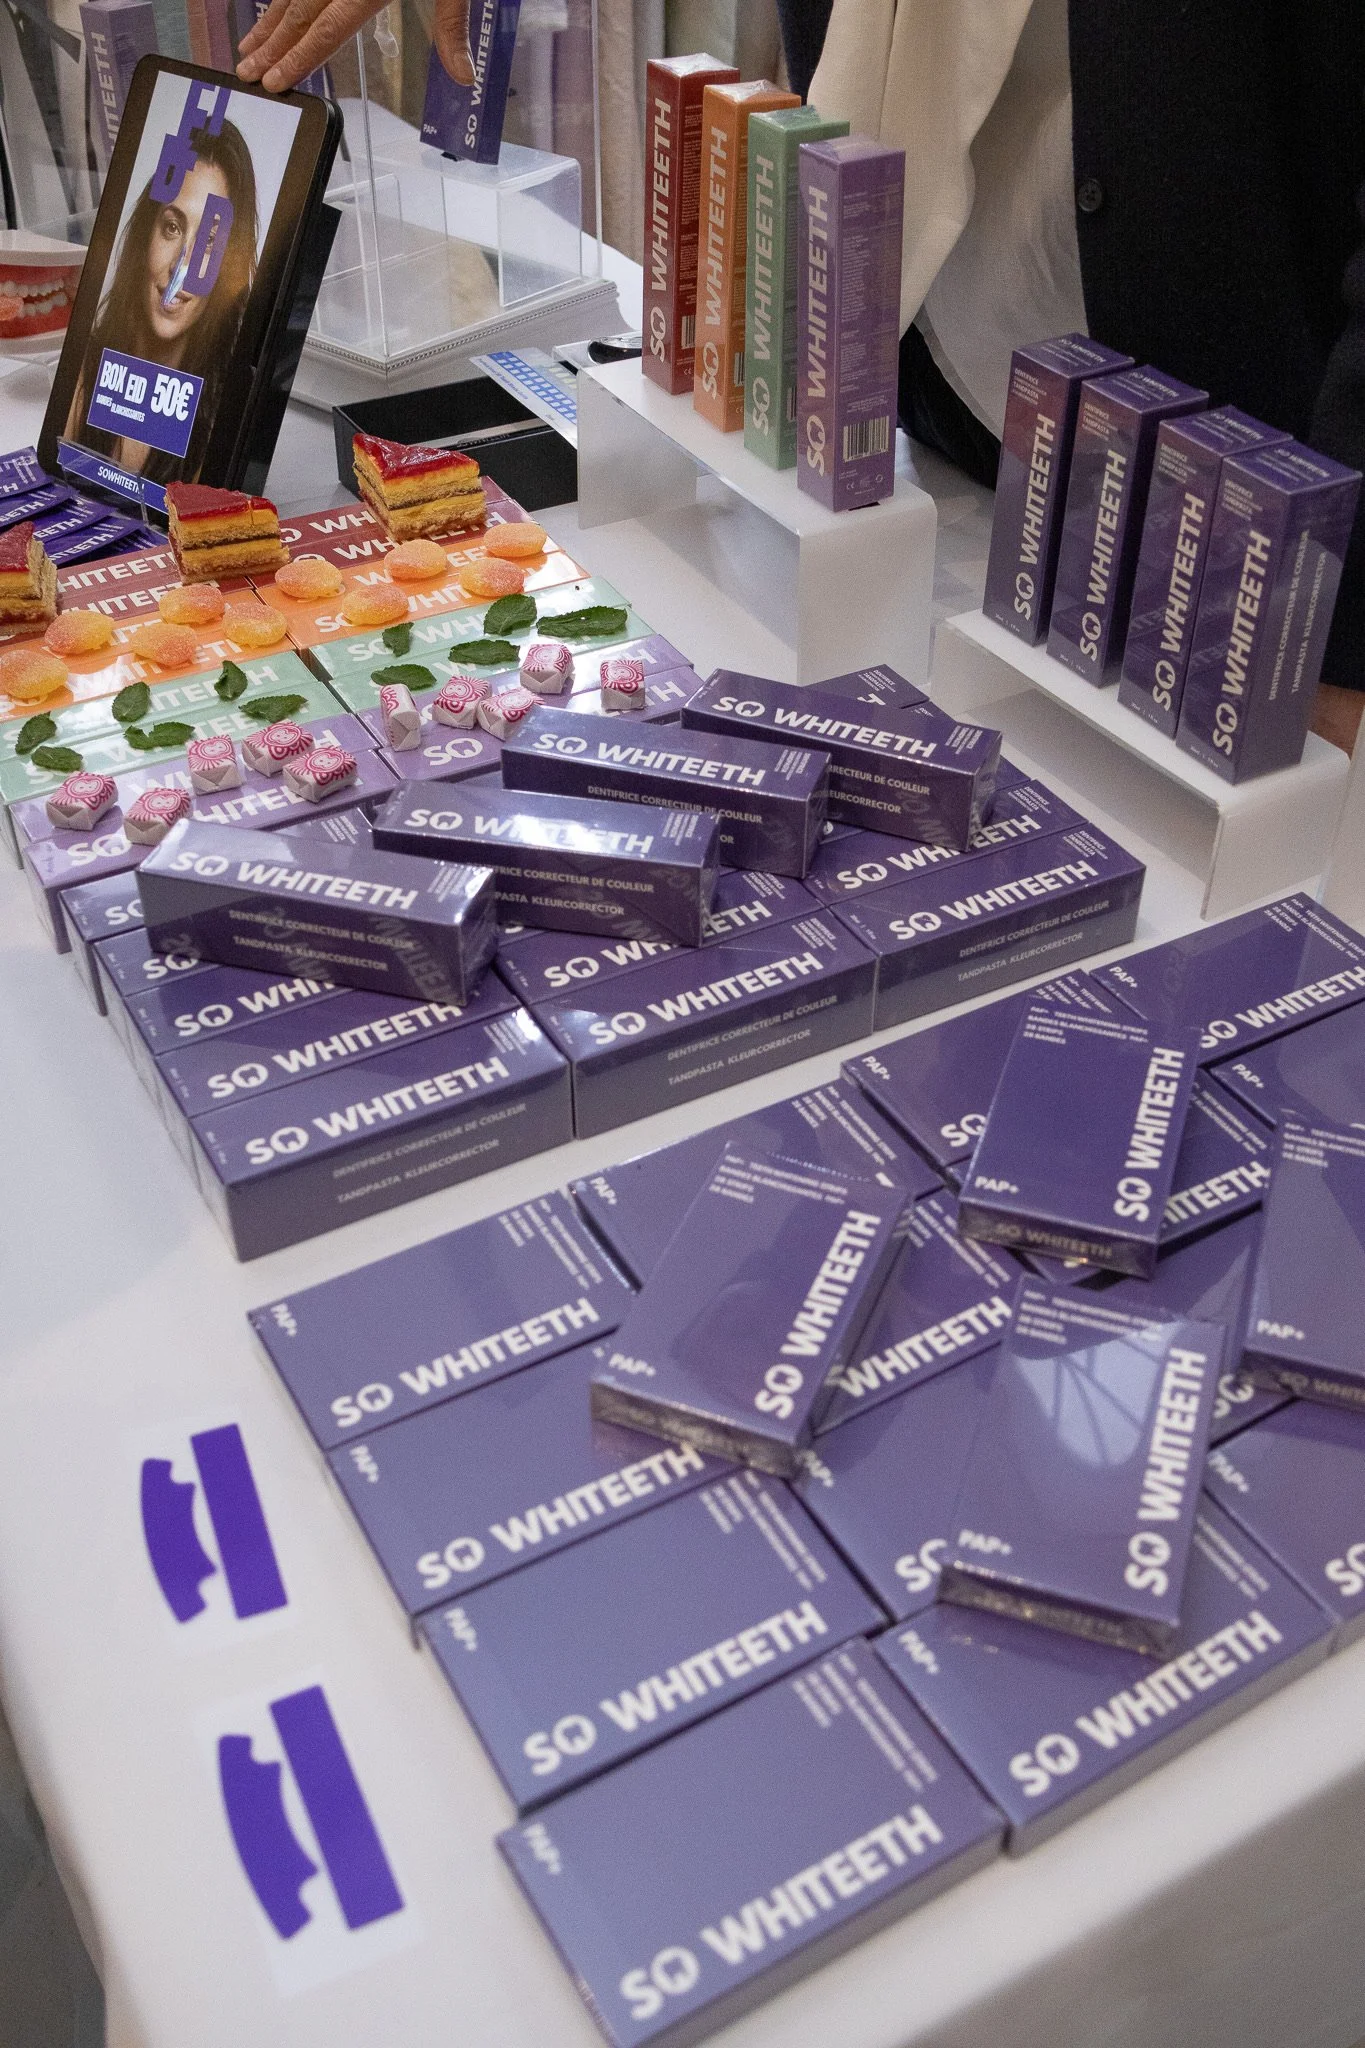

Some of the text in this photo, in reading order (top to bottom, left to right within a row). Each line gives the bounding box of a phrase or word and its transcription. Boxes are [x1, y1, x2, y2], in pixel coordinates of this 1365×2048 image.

[650, 97, 671, 363] SO WHITEETH
[702, 126, 728, 399] SO WHITEETH
[752, 154, 775, 437] SO WHITEETH
[806, 185, 829, 477] SO WHITEETH
[99, 360, 128, 394] BOX
[150, 373, 194, 421] 50€
[1013, 413, 1056, 622] SO WHITEETH
[1080, 449, 1127, 662] SO WHITEETH
[1152, 492, 1205, 712] SO WHITEETH
[1213, 530, 1272, 756] SO WHITEETH
[424, 738, 484, 766] SO
[711, 696, 765, 718] SO
[774, 707, 937, 758] WHITEETH
[532, 733, 587, 754] SO
[597, 742, 766, 786] WHITEETH
[874, 774, 930, 796] DE COULEUR
[404, 808, 463, 831] SO
[587, 785, 639, 803] DENTIFRICE
[640, 795, 701, 814] CORRECTEUR
[718, 808, 763, 824] COULEUR
[829, 789, 902, 814] EURCORRECTOR
[68, 833, 132, 866] SO
[837, 862, 888, 889] SO
[168, 851, 418, 911] SO WHITEETH
[494, 892, 625, 916] PASTA KLEURCORRECTOR
[523, 869, 654, 893] CORRECTEUR DE COULEUR
[889, 860, 1100, 941] SO WHITEETH
[957, 931, 1084, 982] TANDPASTA KLEURCORRECTOR
[959, 900, 1110, 958] DENTIFRICE CORRECTEUR DE COULEUR
[544, 956, 600, 988] SO
[589, 952, 824, 1045] SO WHITEETH
[1109, 966, 1138, 988] PAP+
[1236, 966, 1365, 1029] WHITEETH
[174, 1004, 234, 1036] SO
[721, 1014, 782, 1046] CORRECTEUR
[782, 1008, 795, 1021] DE
[796, 995, 838, 1017] COULEUR
[207, 1001, 464, 1098] SO WHITEETH
[668, 1029, 811, 1086] TANDPASTA KLEURCORRECTOR
[862, 1055, 890, 1081] PAP+
[1232, 1063, 1264, 1088] PAP+
[245, 1056, 511, 1165] SO WHITEETH
[1114, 1047, 1185, 1223] SO WHITEETH
[589, 1177, 618, 1205] PAP+
[975, 1175, 1020, 1195] PAP+
[269, 1303, 297, 1336] PAP+
[754, 1363, 804, 1419] SO
[782, 1209, 882, 1357] WHITEETH
[1257, 1318, 1305, 1341] PAP+
[331, 1298, 601, 1428] SO WHITEETH
[608, 1353, 656, 1377] PAP+
[839, 1296, 1013, 1398] WHITEETH
[349, 1445, 380, 1484] PAP+
[1124, 1347, 1207, 1597] SO WHITEETH
[1207, 1449, 1250, 1493] PAP+
[416, 1536, 486, 1589] SO
[488, 1442, 705, 1551] WHITEETH
[957, 1529, 1013, 1555] PAP+
[444, 1607, 478, 1651] PAP+
[899, 1630, 941, 1675] PAP+
[523, 1713, 597, 1776] SO
[600, 1602, 828, 1732] WHITEETH
[1008, 1610, 1283, 1798] SO WHITEETH
[619, 1805, 944, 2021] SO WHITEETH
